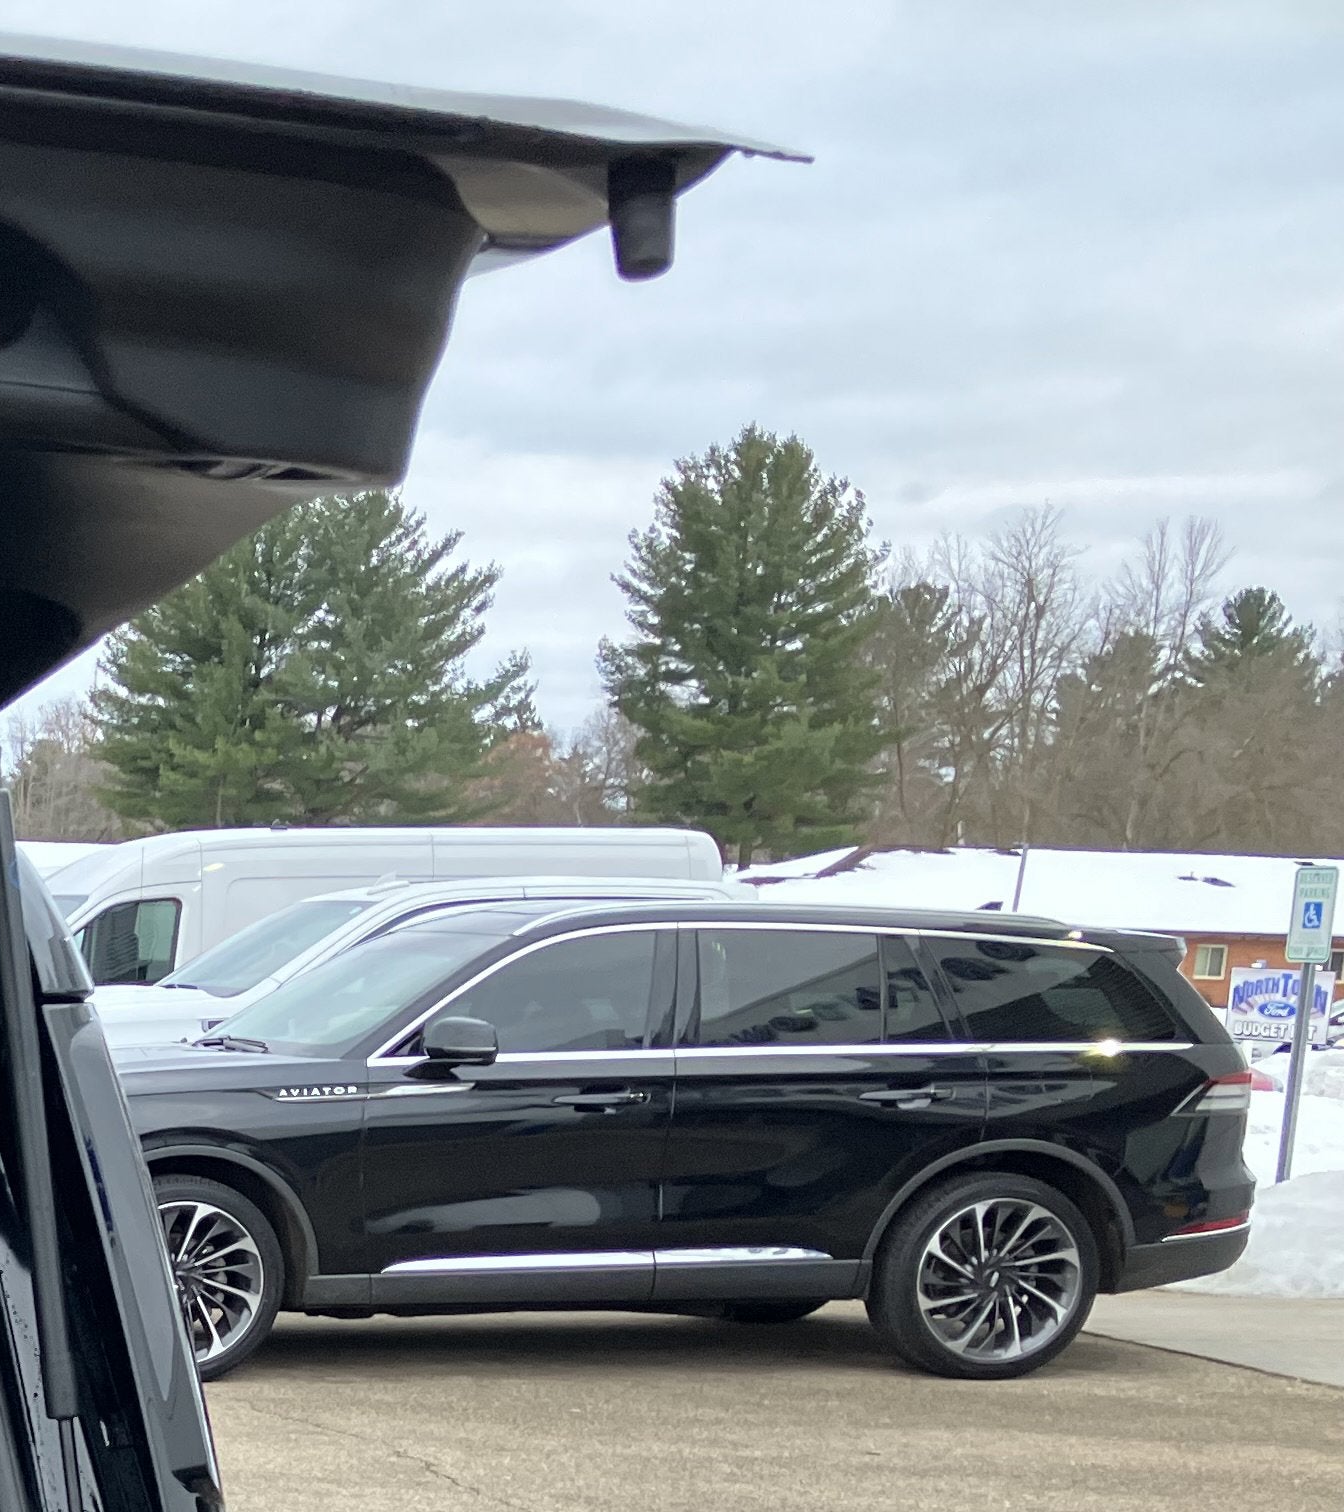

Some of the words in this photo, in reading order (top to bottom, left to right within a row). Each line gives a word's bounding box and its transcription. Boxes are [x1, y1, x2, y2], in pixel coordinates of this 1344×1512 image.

[1264, 1002, 1291, 1017] Ford
[1234, 1021, 1288, 1038] BUDGET
[1288, 1023, 1317, 1041] LT
[279, 1086, 358, 1097] AVIATOR
